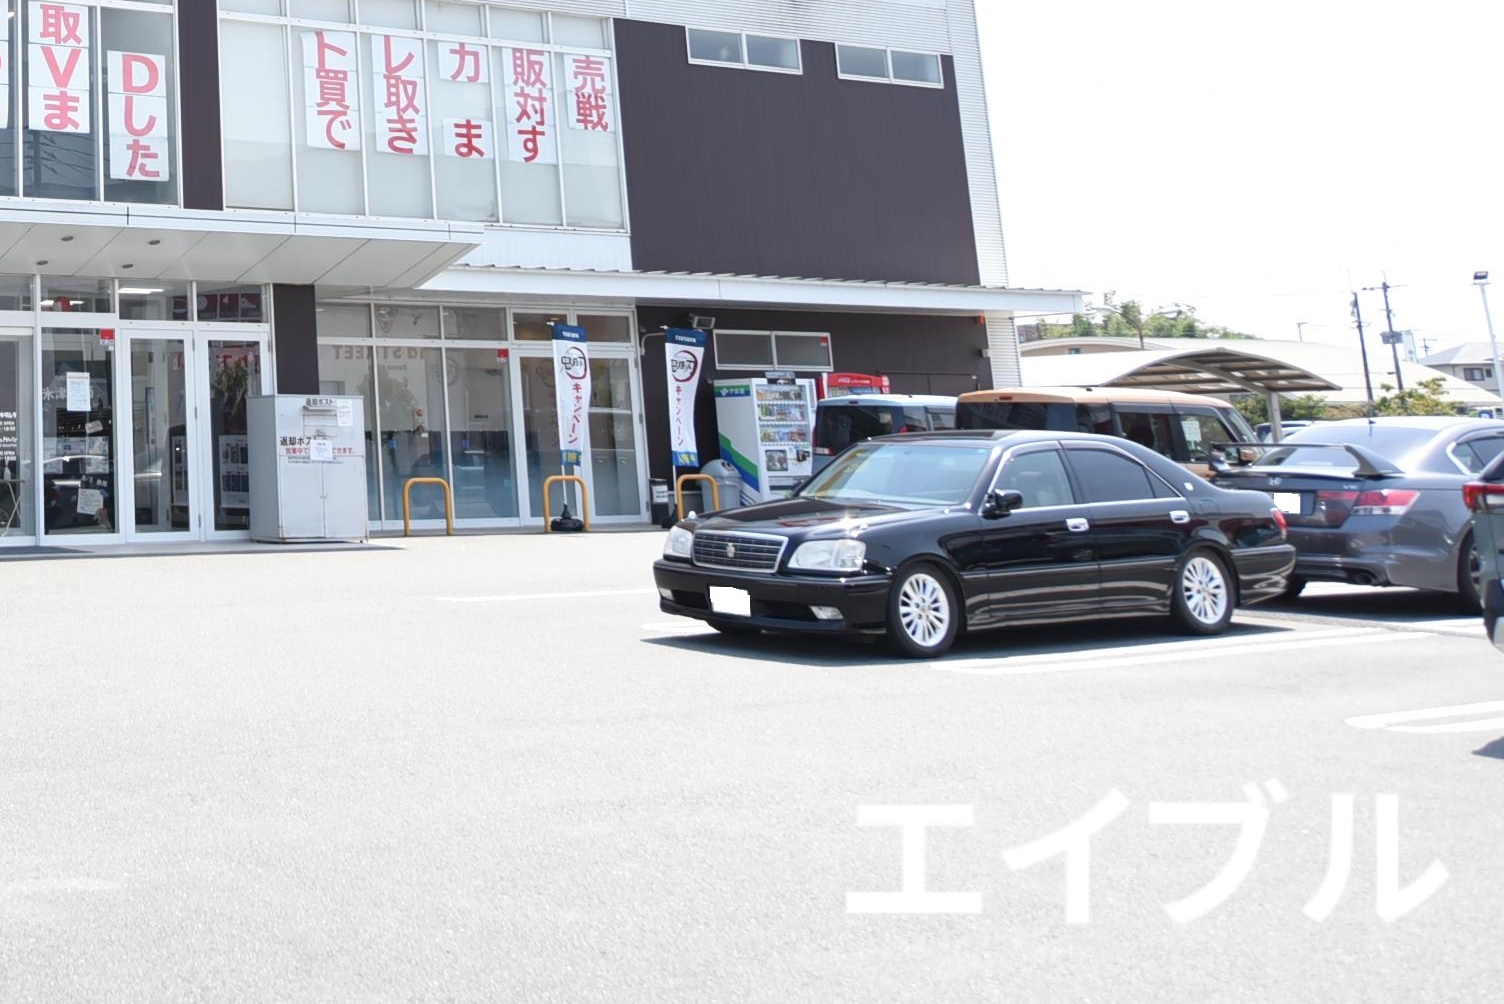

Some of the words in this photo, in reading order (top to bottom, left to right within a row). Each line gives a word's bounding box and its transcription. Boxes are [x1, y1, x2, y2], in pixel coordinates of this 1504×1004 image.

[568, 382, 583, 444] キャンペーン
